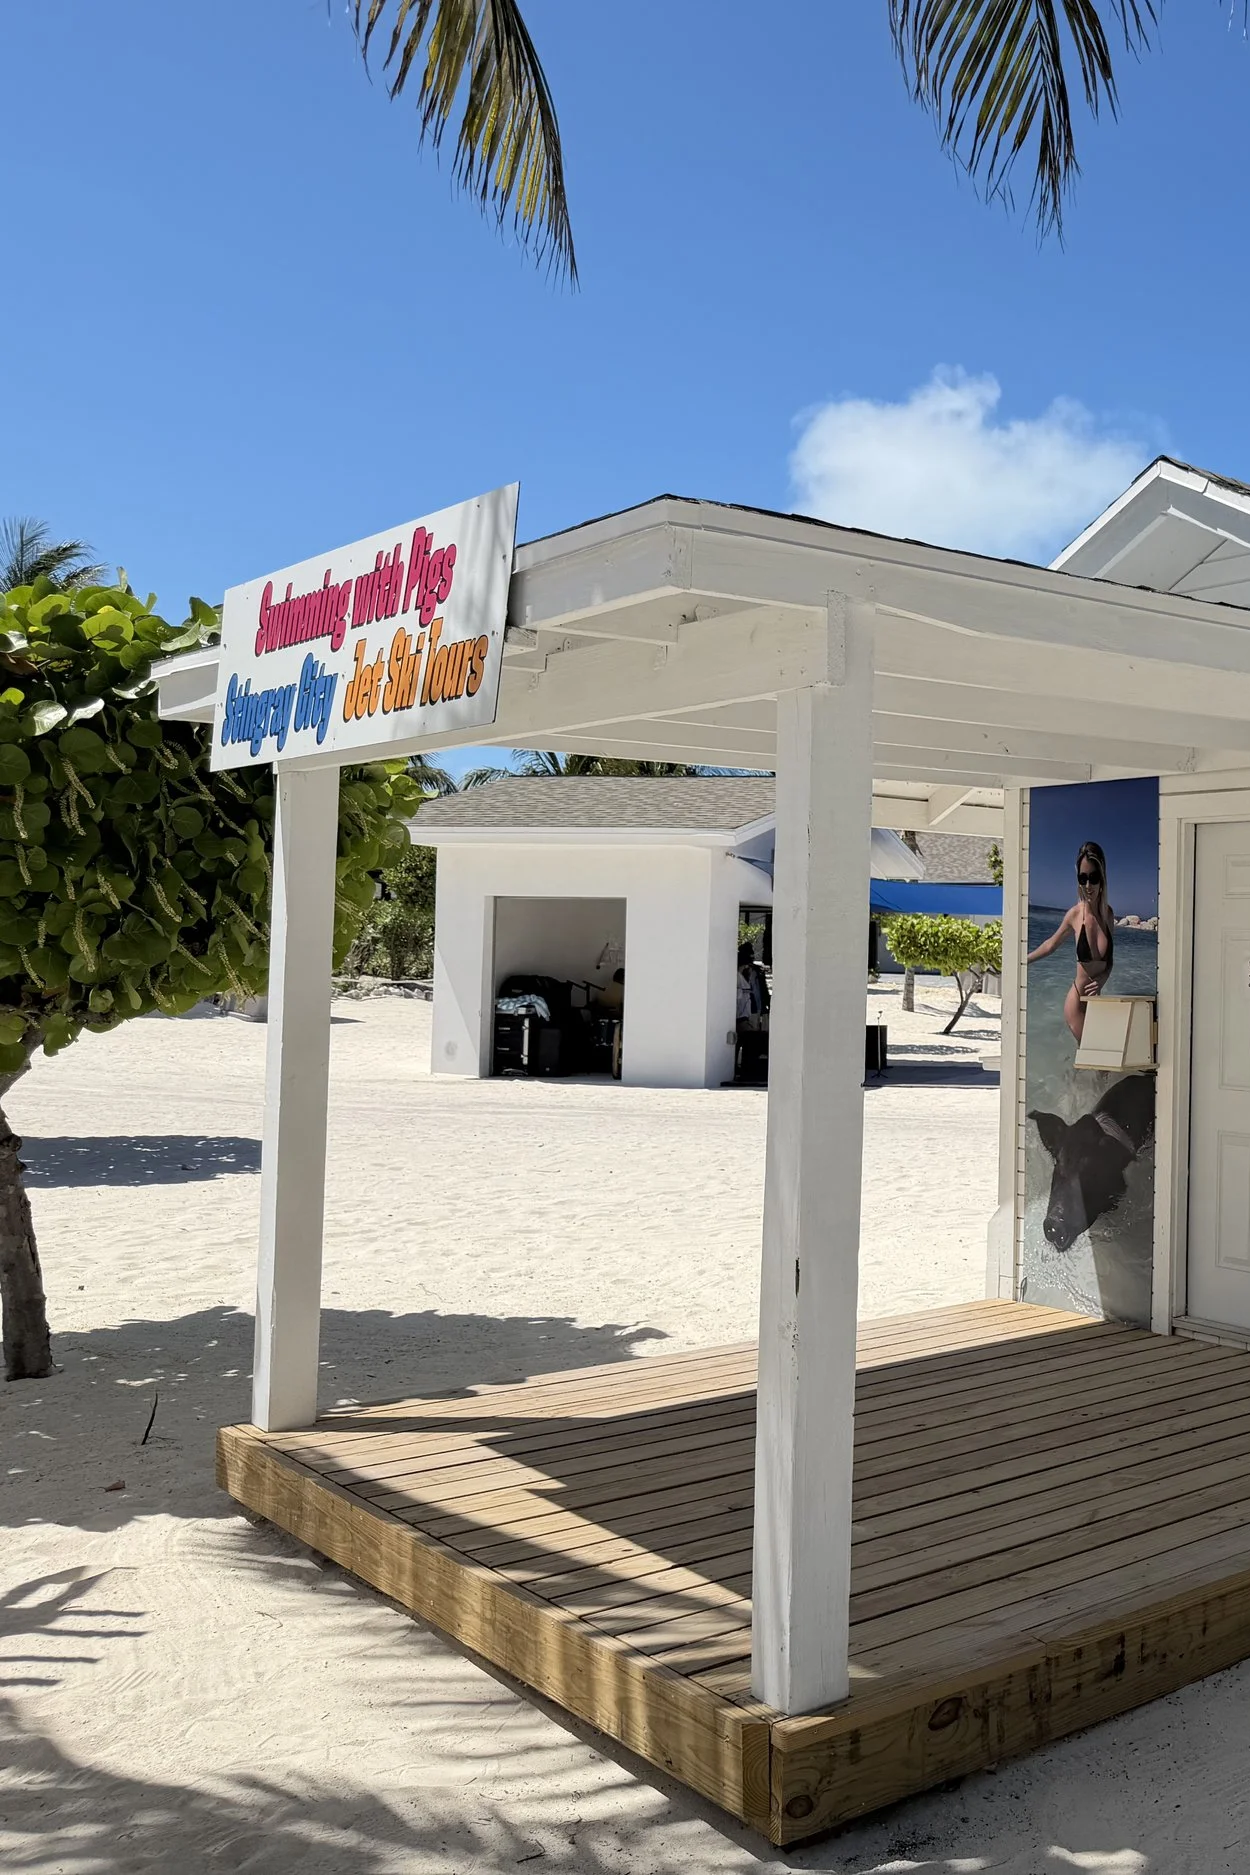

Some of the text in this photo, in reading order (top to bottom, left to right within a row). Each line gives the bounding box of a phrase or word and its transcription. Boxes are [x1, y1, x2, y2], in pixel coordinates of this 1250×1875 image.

[255, 526, 457, 657] Swimming with Pigs
[221, 616, 489, 757] Stingray City Jet Ski Tours
